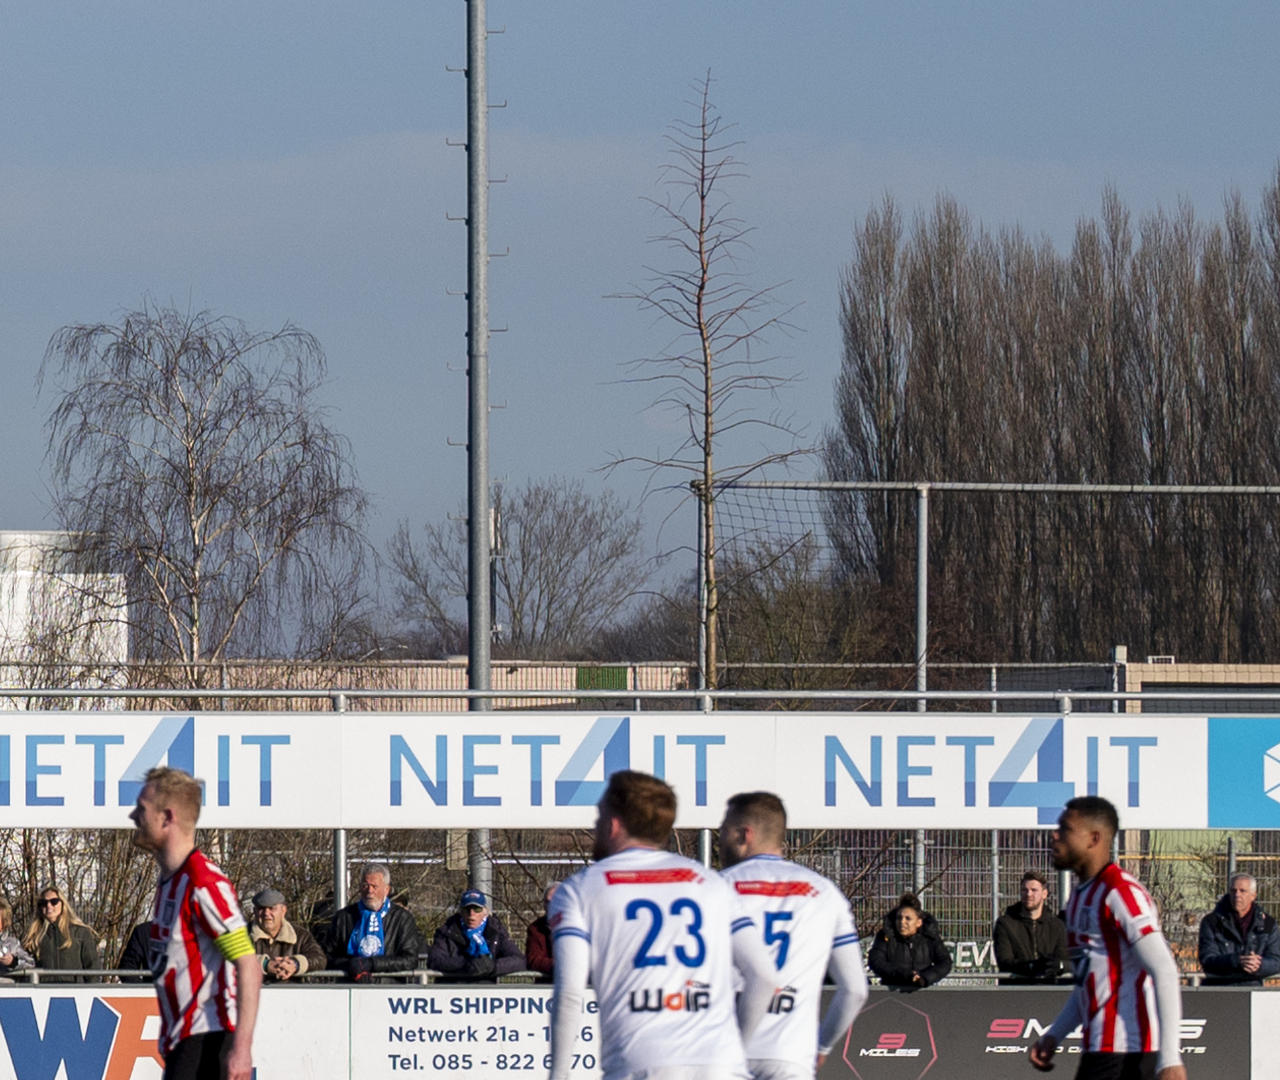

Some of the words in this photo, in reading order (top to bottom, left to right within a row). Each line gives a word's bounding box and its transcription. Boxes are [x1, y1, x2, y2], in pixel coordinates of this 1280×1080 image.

[824, 718, 1158, 825] NET4IT
[625, 897, 706, 968] 23
[764, 911, 793, 971] 5
[388, 998, 443, 1014] WRL
[388, 1026, 479, 1042] Netwerk
[486, 1026, 519, 1042] 21a
[859, 1048, 921, 1057] MILES
[388, 1054, 425, 1070] Tel.
[432, 1054, 474, 1070] 085
[495, 1054, 536, 1070] 822
[543, 1054, 597, 1070] 670
